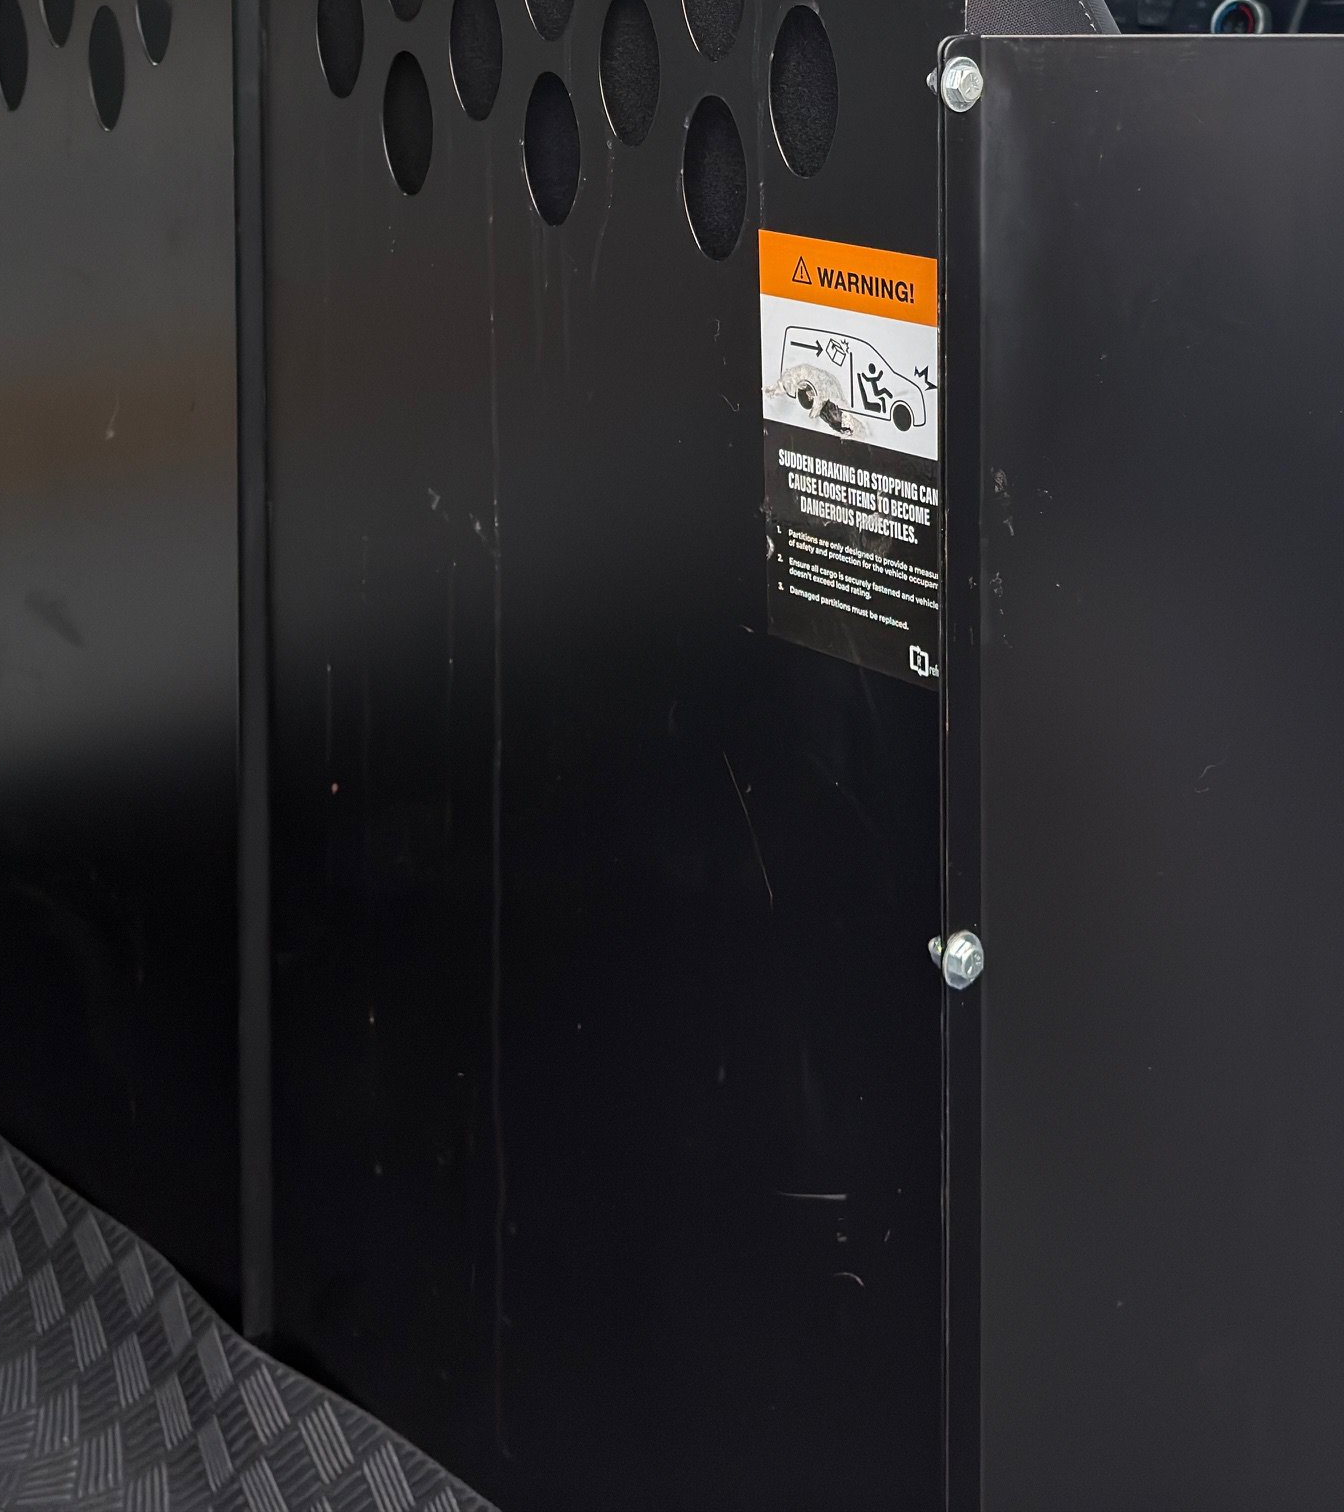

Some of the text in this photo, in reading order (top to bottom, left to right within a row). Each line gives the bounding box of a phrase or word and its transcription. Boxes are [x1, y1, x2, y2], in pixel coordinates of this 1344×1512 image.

[817, 266, 915, 304] WARNING!
[778, 448, 939, 507] SUDDEN BRAKING OR STOPPING CAN
[788, 471, 931, 526] CAUSE LOOSE ITEMS TO BECOME
[800, 495, 919, 545] DANGEROUS PROJECTILES.
[788, 528, 818, 545] Partitions
[818, 537, 830, 548] are
[829, 539, 844, 554] only
[844, 545, 875, 562] designed
[874, 553, 883, 563] to
[883, 555, 908, 572] provide
[908, 565, 914, 573] a
[788, 539, 796, 548] of
[795, 540, 815, 555] safety
[815, 547, 828, 557] and
[828, 550, 862, 567] protection
[861, 559, 872, 570] for
[872, 562, 884, 574] the
[884, 566, 908, 581] vehicle
[777, 553, 784, 563] 2.
[788, 557, 811, 571] Ensure
[810, 563, 820, 574] all
[819, 567, 838, 580] cargo
[838, 571, 845, 581] is
[844, 573, 872, 591] securely
[872, 581, 901, 599] fastened
[901, 589, 915, 602] and
[788, 566, 872, 600] doesn't exceed load rating.
[777, 581, 910, 631] 3. Damaged partitions must be replaced.
